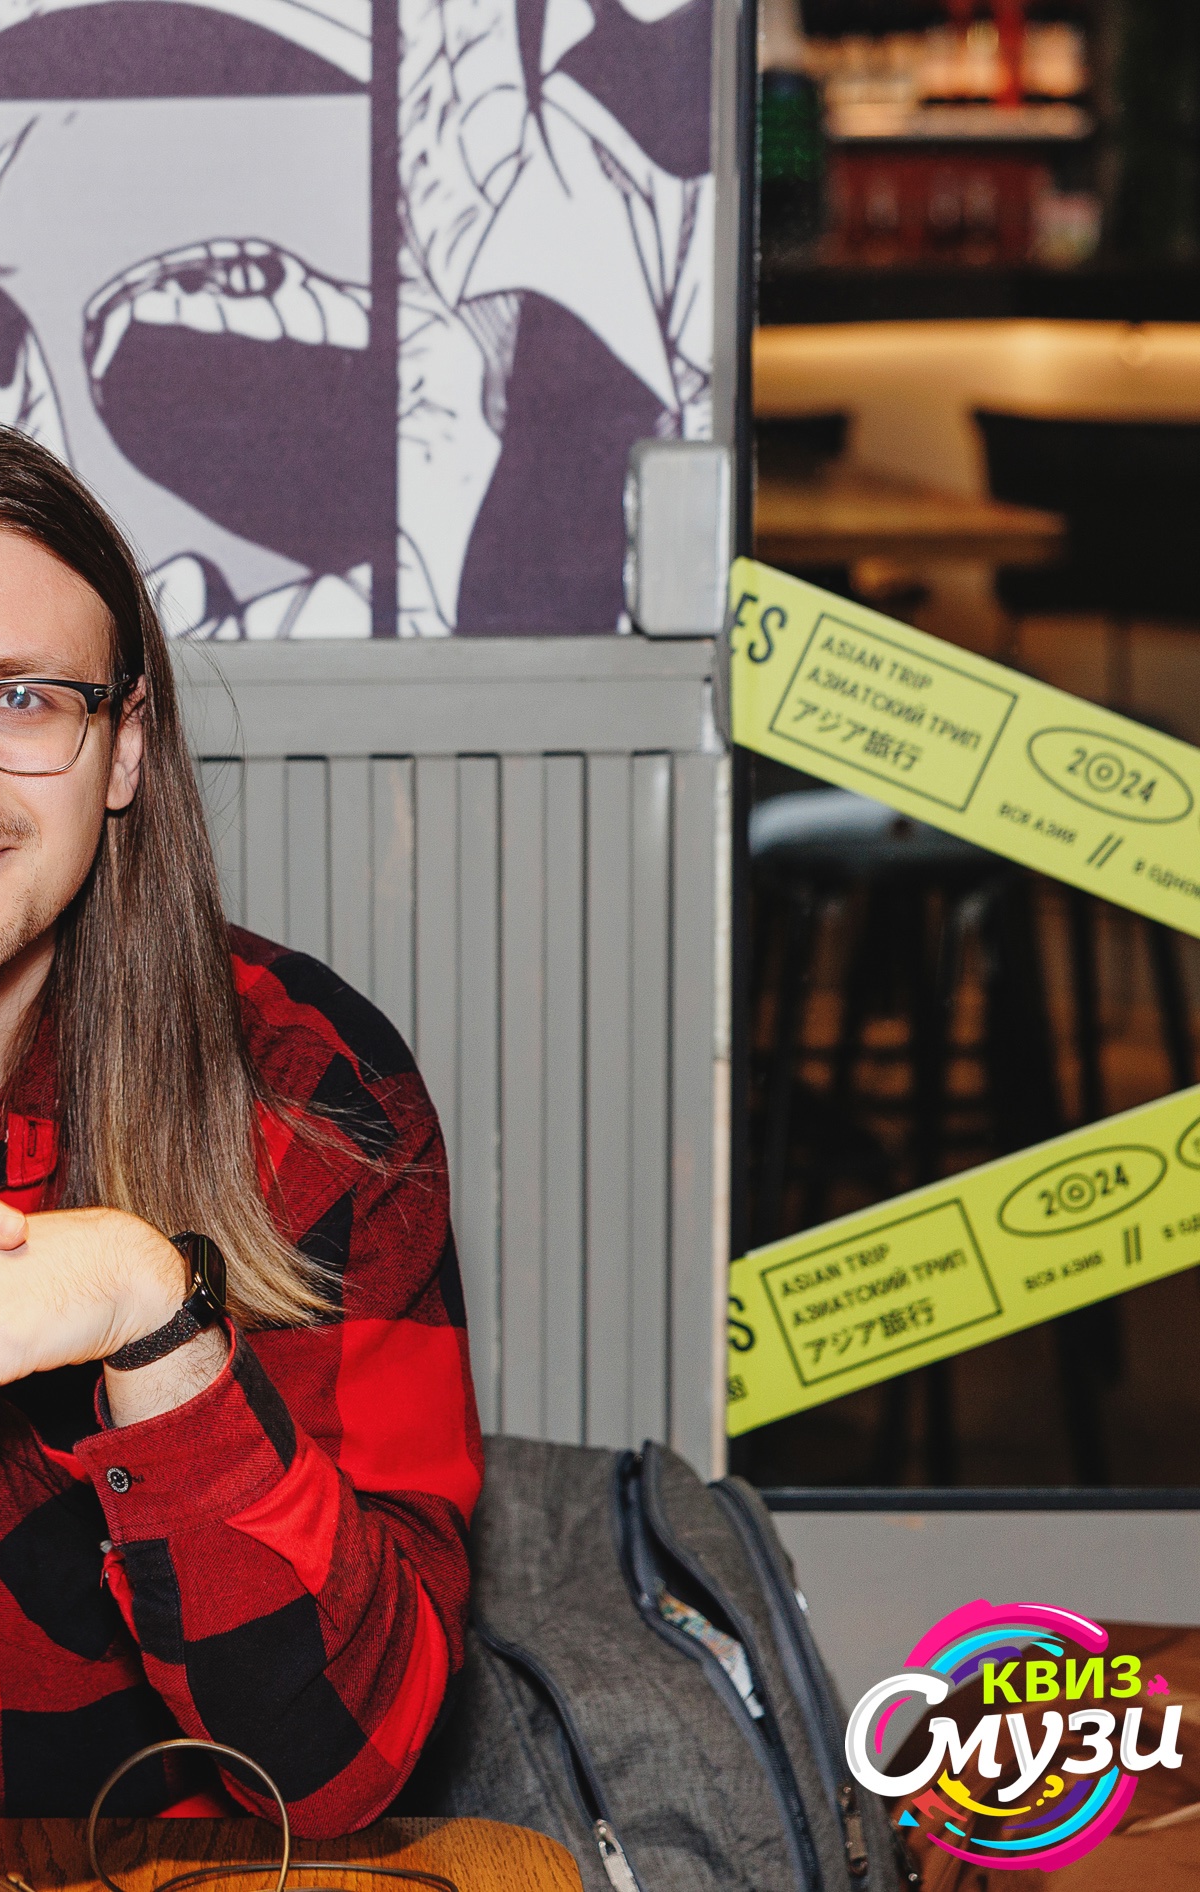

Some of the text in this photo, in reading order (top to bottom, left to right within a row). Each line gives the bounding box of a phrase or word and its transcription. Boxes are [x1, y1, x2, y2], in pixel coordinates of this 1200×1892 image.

[820, 634, 933, 692] ASIAN TRIP
[806, 665, 982, 751] АЗИАТСКИЙ ТРИП
[780, 1243, 891, 1298] ASIAN TRIP
[793, 1247, 967, 1329] АЗИАТСКИЙ ТРИП
